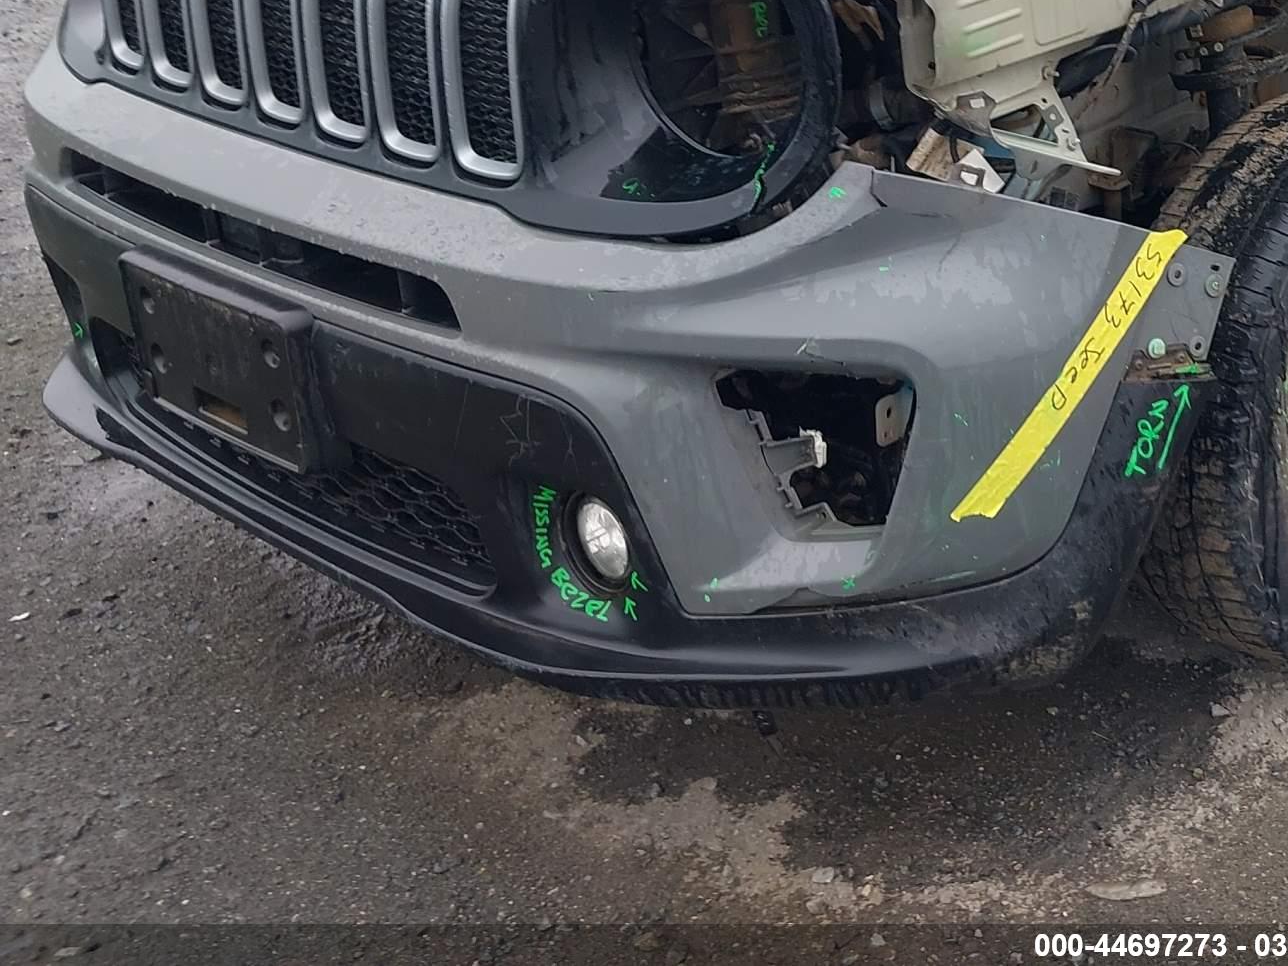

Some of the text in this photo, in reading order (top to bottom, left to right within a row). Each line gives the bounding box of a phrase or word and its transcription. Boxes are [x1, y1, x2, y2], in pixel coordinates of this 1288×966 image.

[1103, 243, 1163, 328] 53173
[1124, 398, 1170, 477] TORN
[532, 484, 558, 569] MISSING
